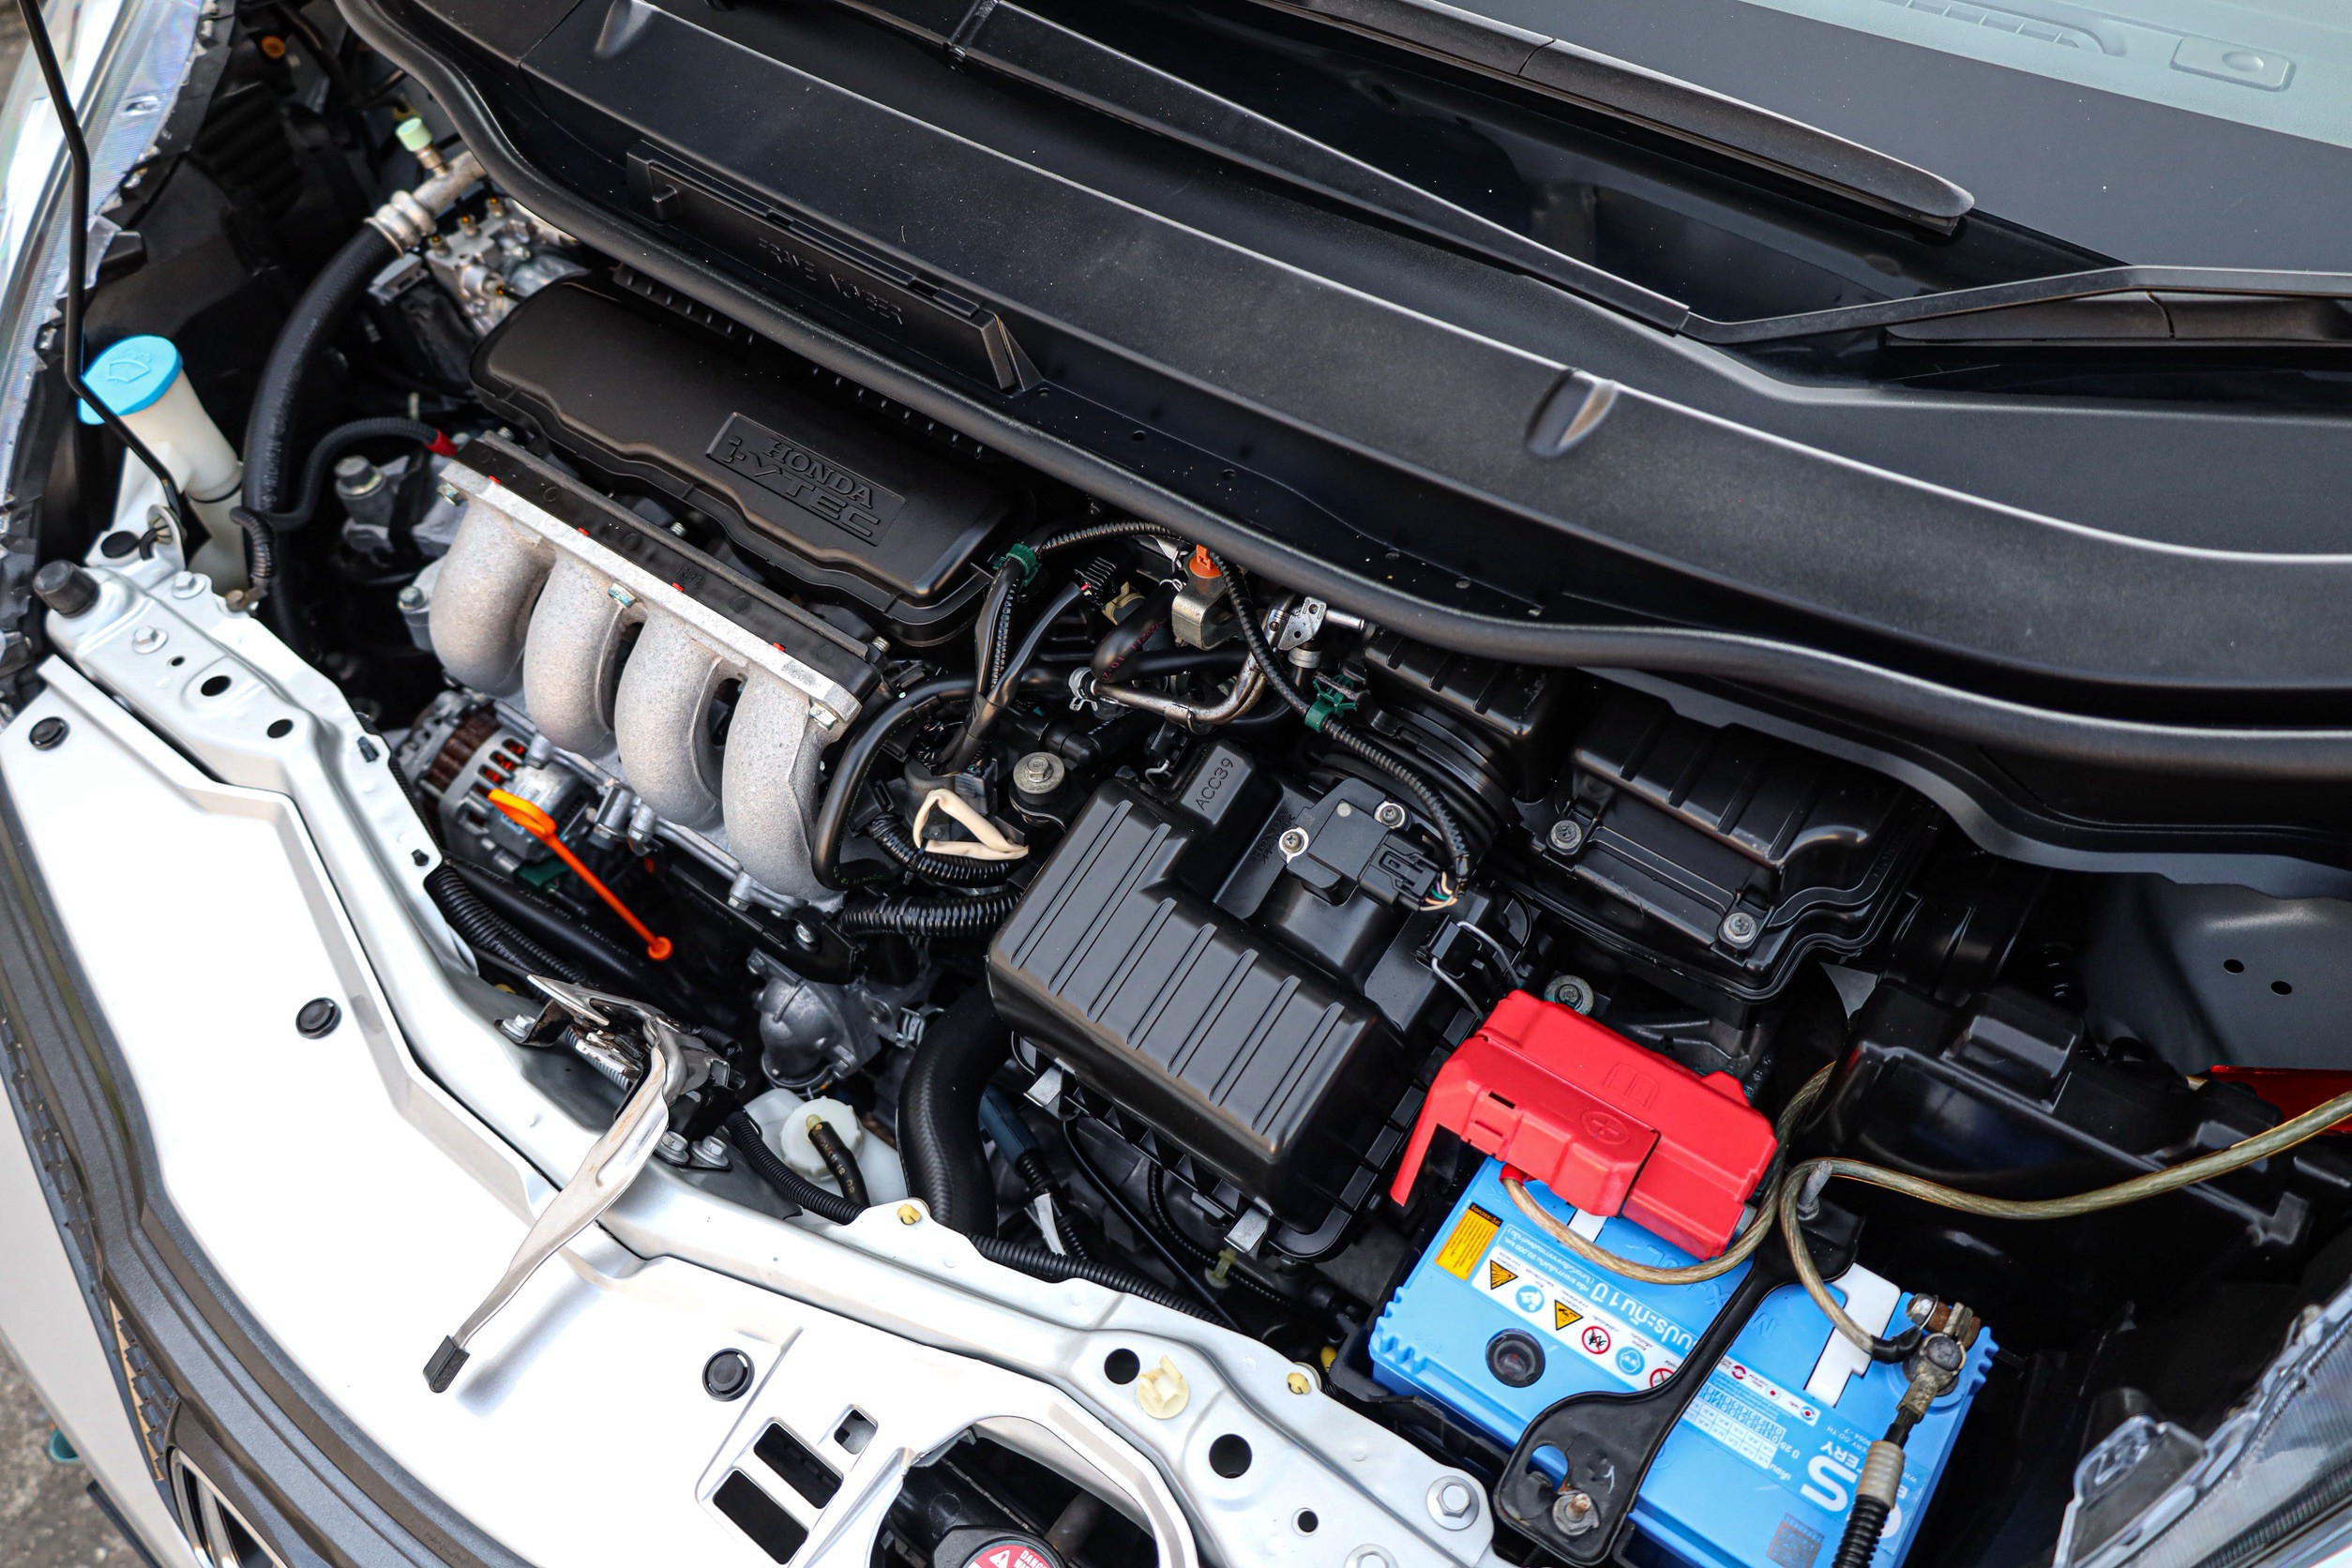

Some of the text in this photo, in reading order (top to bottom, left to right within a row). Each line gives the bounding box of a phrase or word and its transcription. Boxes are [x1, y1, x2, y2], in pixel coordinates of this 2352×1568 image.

[760, 436, 874, 510] HONDA
[1191, 755, 1235, 811] ACC39
[1501, 1235, 1515, 1248] km.
[1514, 1242, 1538, 1260] 20,000
[1589, 1279, 1611, 1304] ปี
[1606, 1289, 1623, 1308] 1
[1617, 1296, 1698, 1357] บประกัน
[1777, 1440, 1801, 1460] ปี 25
[1767, 1461, 1792, 1483] เดือน
